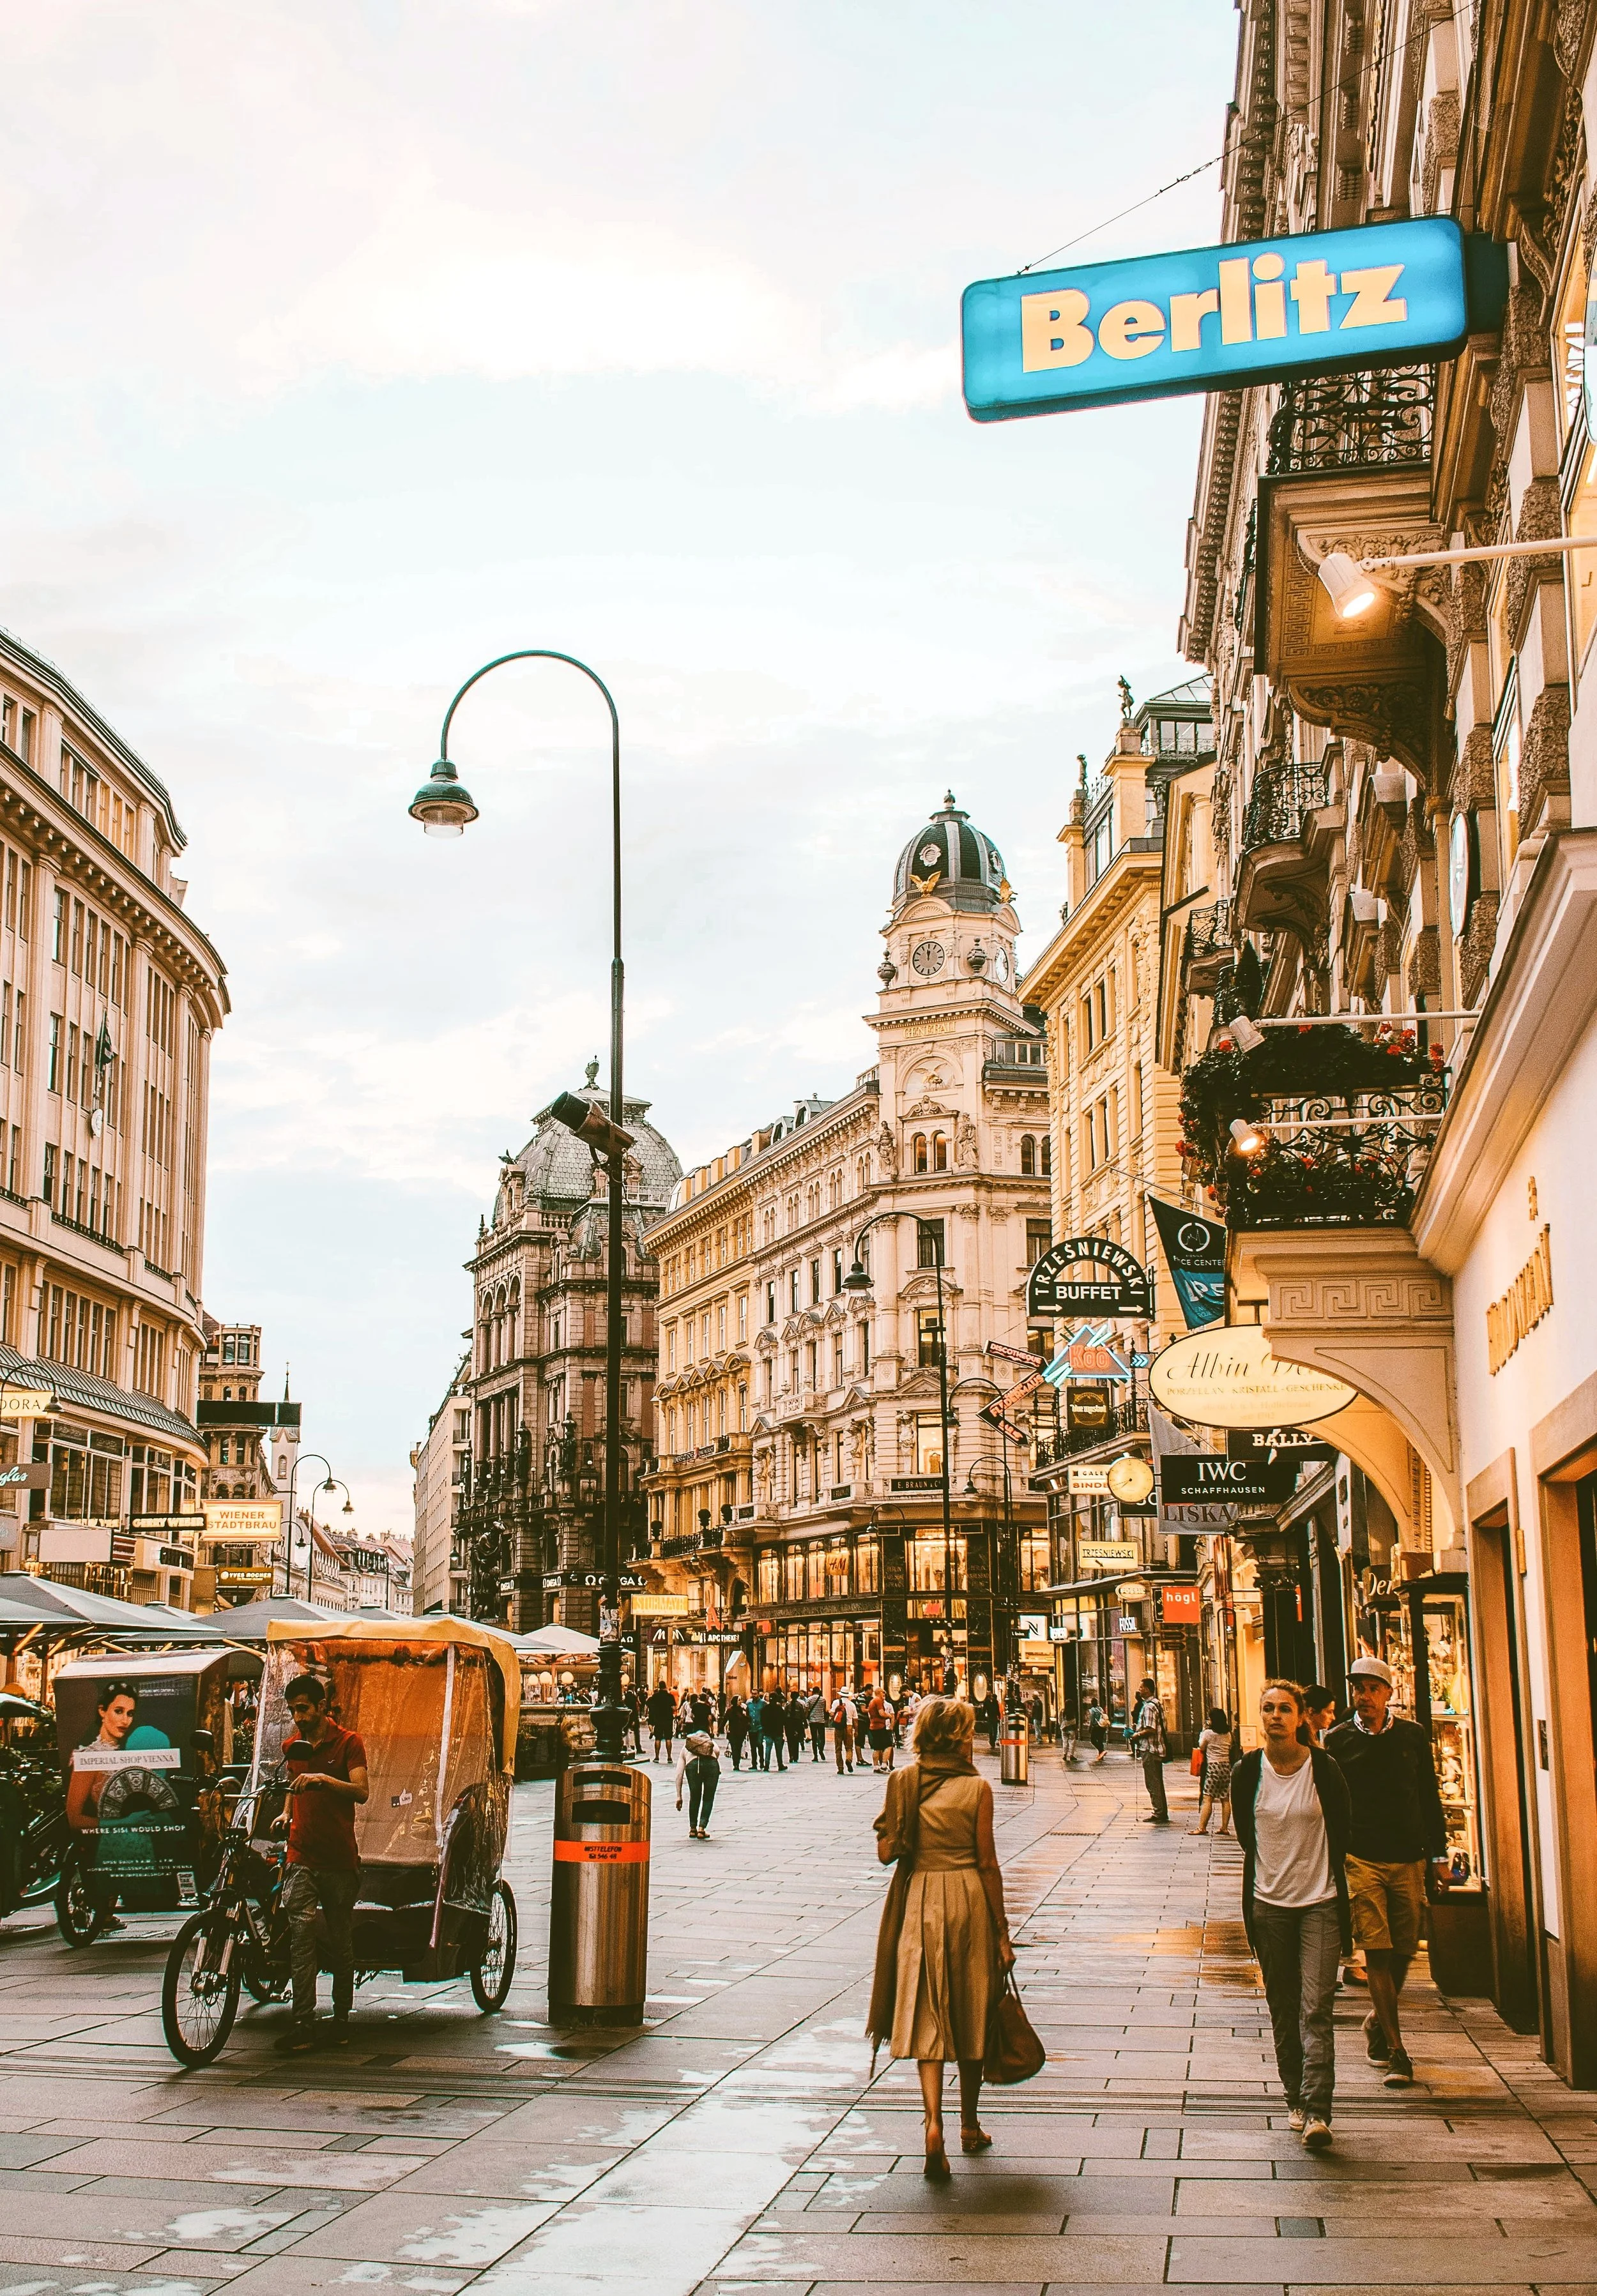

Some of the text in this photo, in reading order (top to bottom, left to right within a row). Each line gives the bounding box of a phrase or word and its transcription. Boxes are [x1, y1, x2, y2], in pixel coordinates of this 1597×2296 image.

[1021, 253, 1407, 373] Berlitz
[903, 1022, 956, 1039] GENERALI
[1035, 1241, 1144, 1296] TRZEŚNIEWSKI
[1056, 1286, 1122, 1300] BUFFET
[990, 1342, 1043, 1364] DISCOTHEQUE
[1166, 1351, 1249, 1380] Albin
[1167, 1387, 1225, 1395] PORZELLAN
[1252, 1433, 1314, 1447] BALLY
[1197, 1462, 1246, 1482] IWC
[1181, 1486, 1266, 1495] SCHAFFHAUSEN
[1163, 1505, 1234, 1523] LISKA
[1119, 1616, 1137, 1631] FOSSIL
[80, 1757, 118, 1766] IMPERIAL
[143, 1754, 174, 1763] VIENNA
